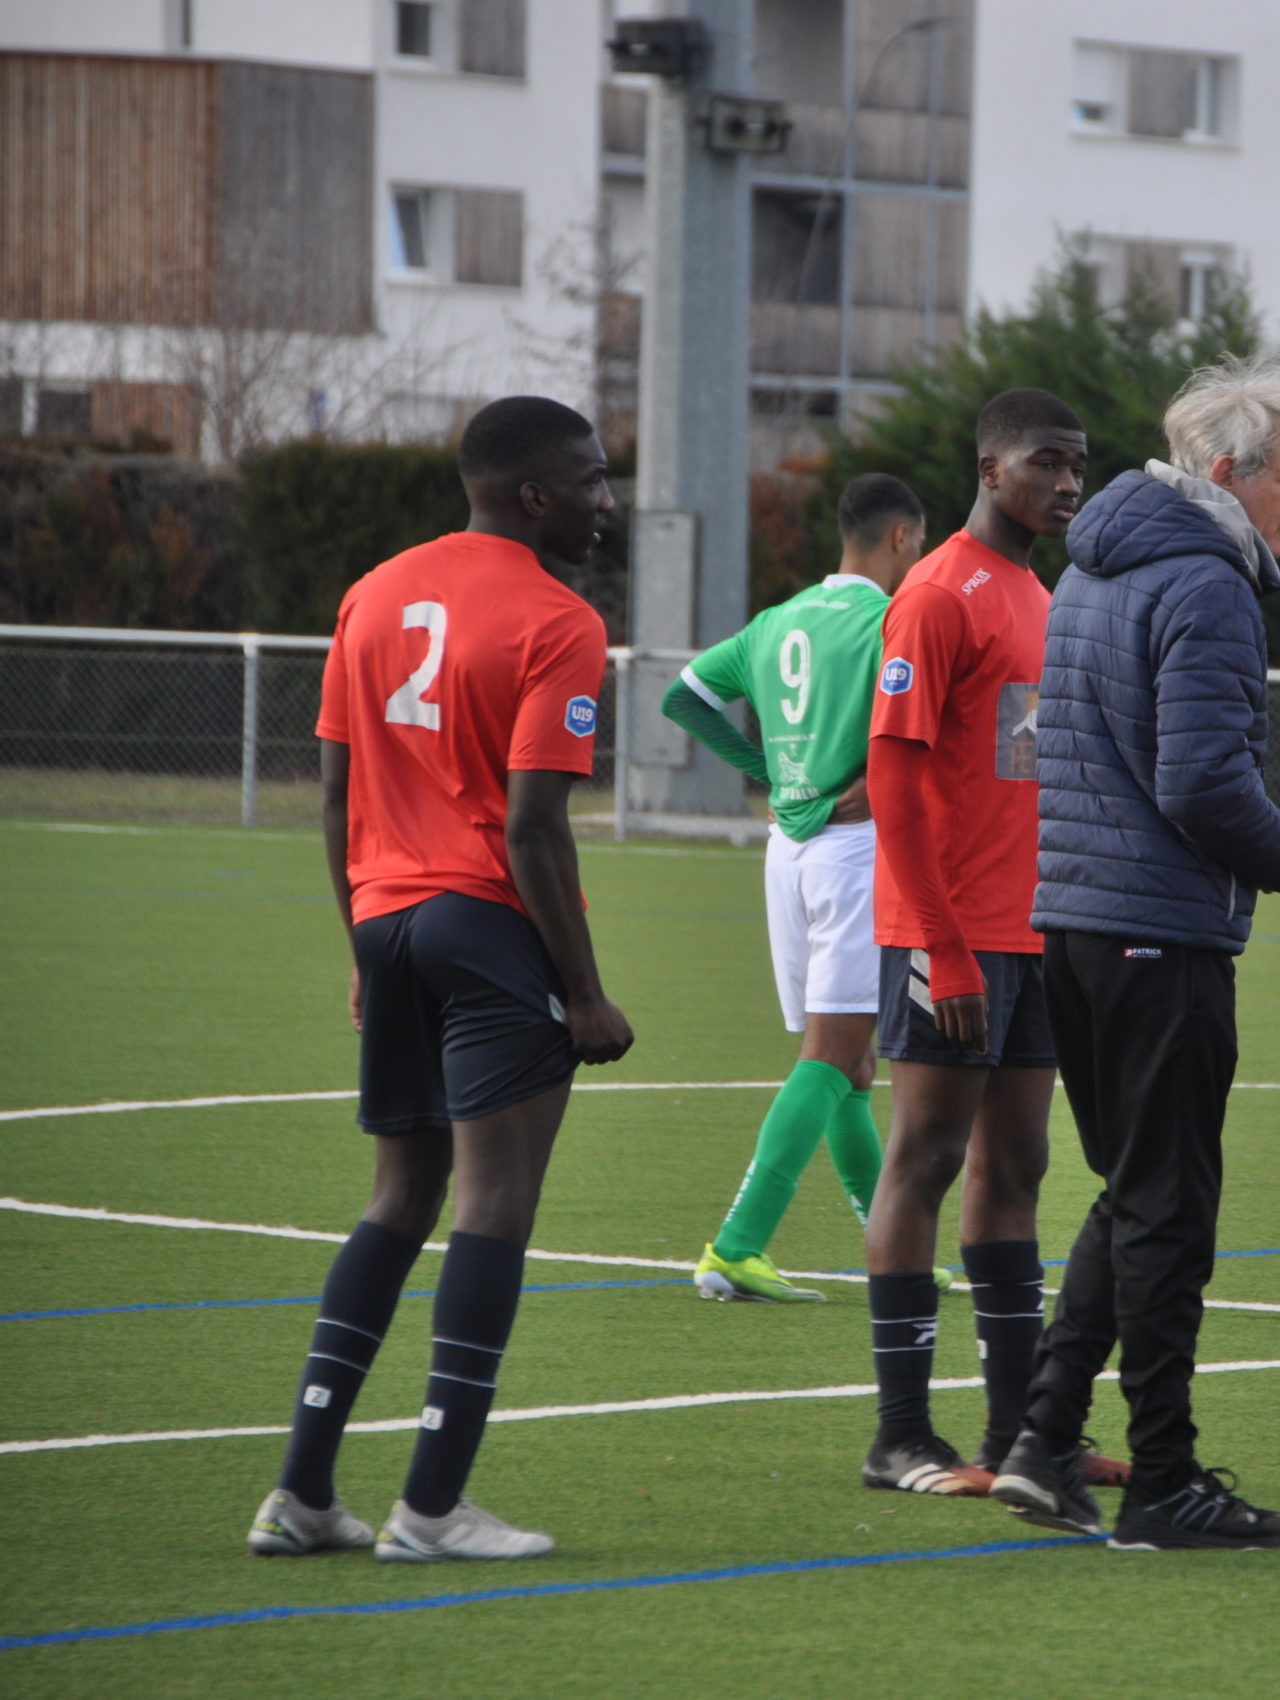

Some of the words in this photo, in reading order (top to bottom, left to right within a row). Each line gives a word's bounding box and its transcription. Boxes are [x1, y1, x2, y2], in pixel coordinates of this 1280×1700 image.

[384, 600, 448, 731] 2
[779, 629, 811, 724] 9
[885, 667, 907, 681] U19
[572, 704, 593, 722] U19
